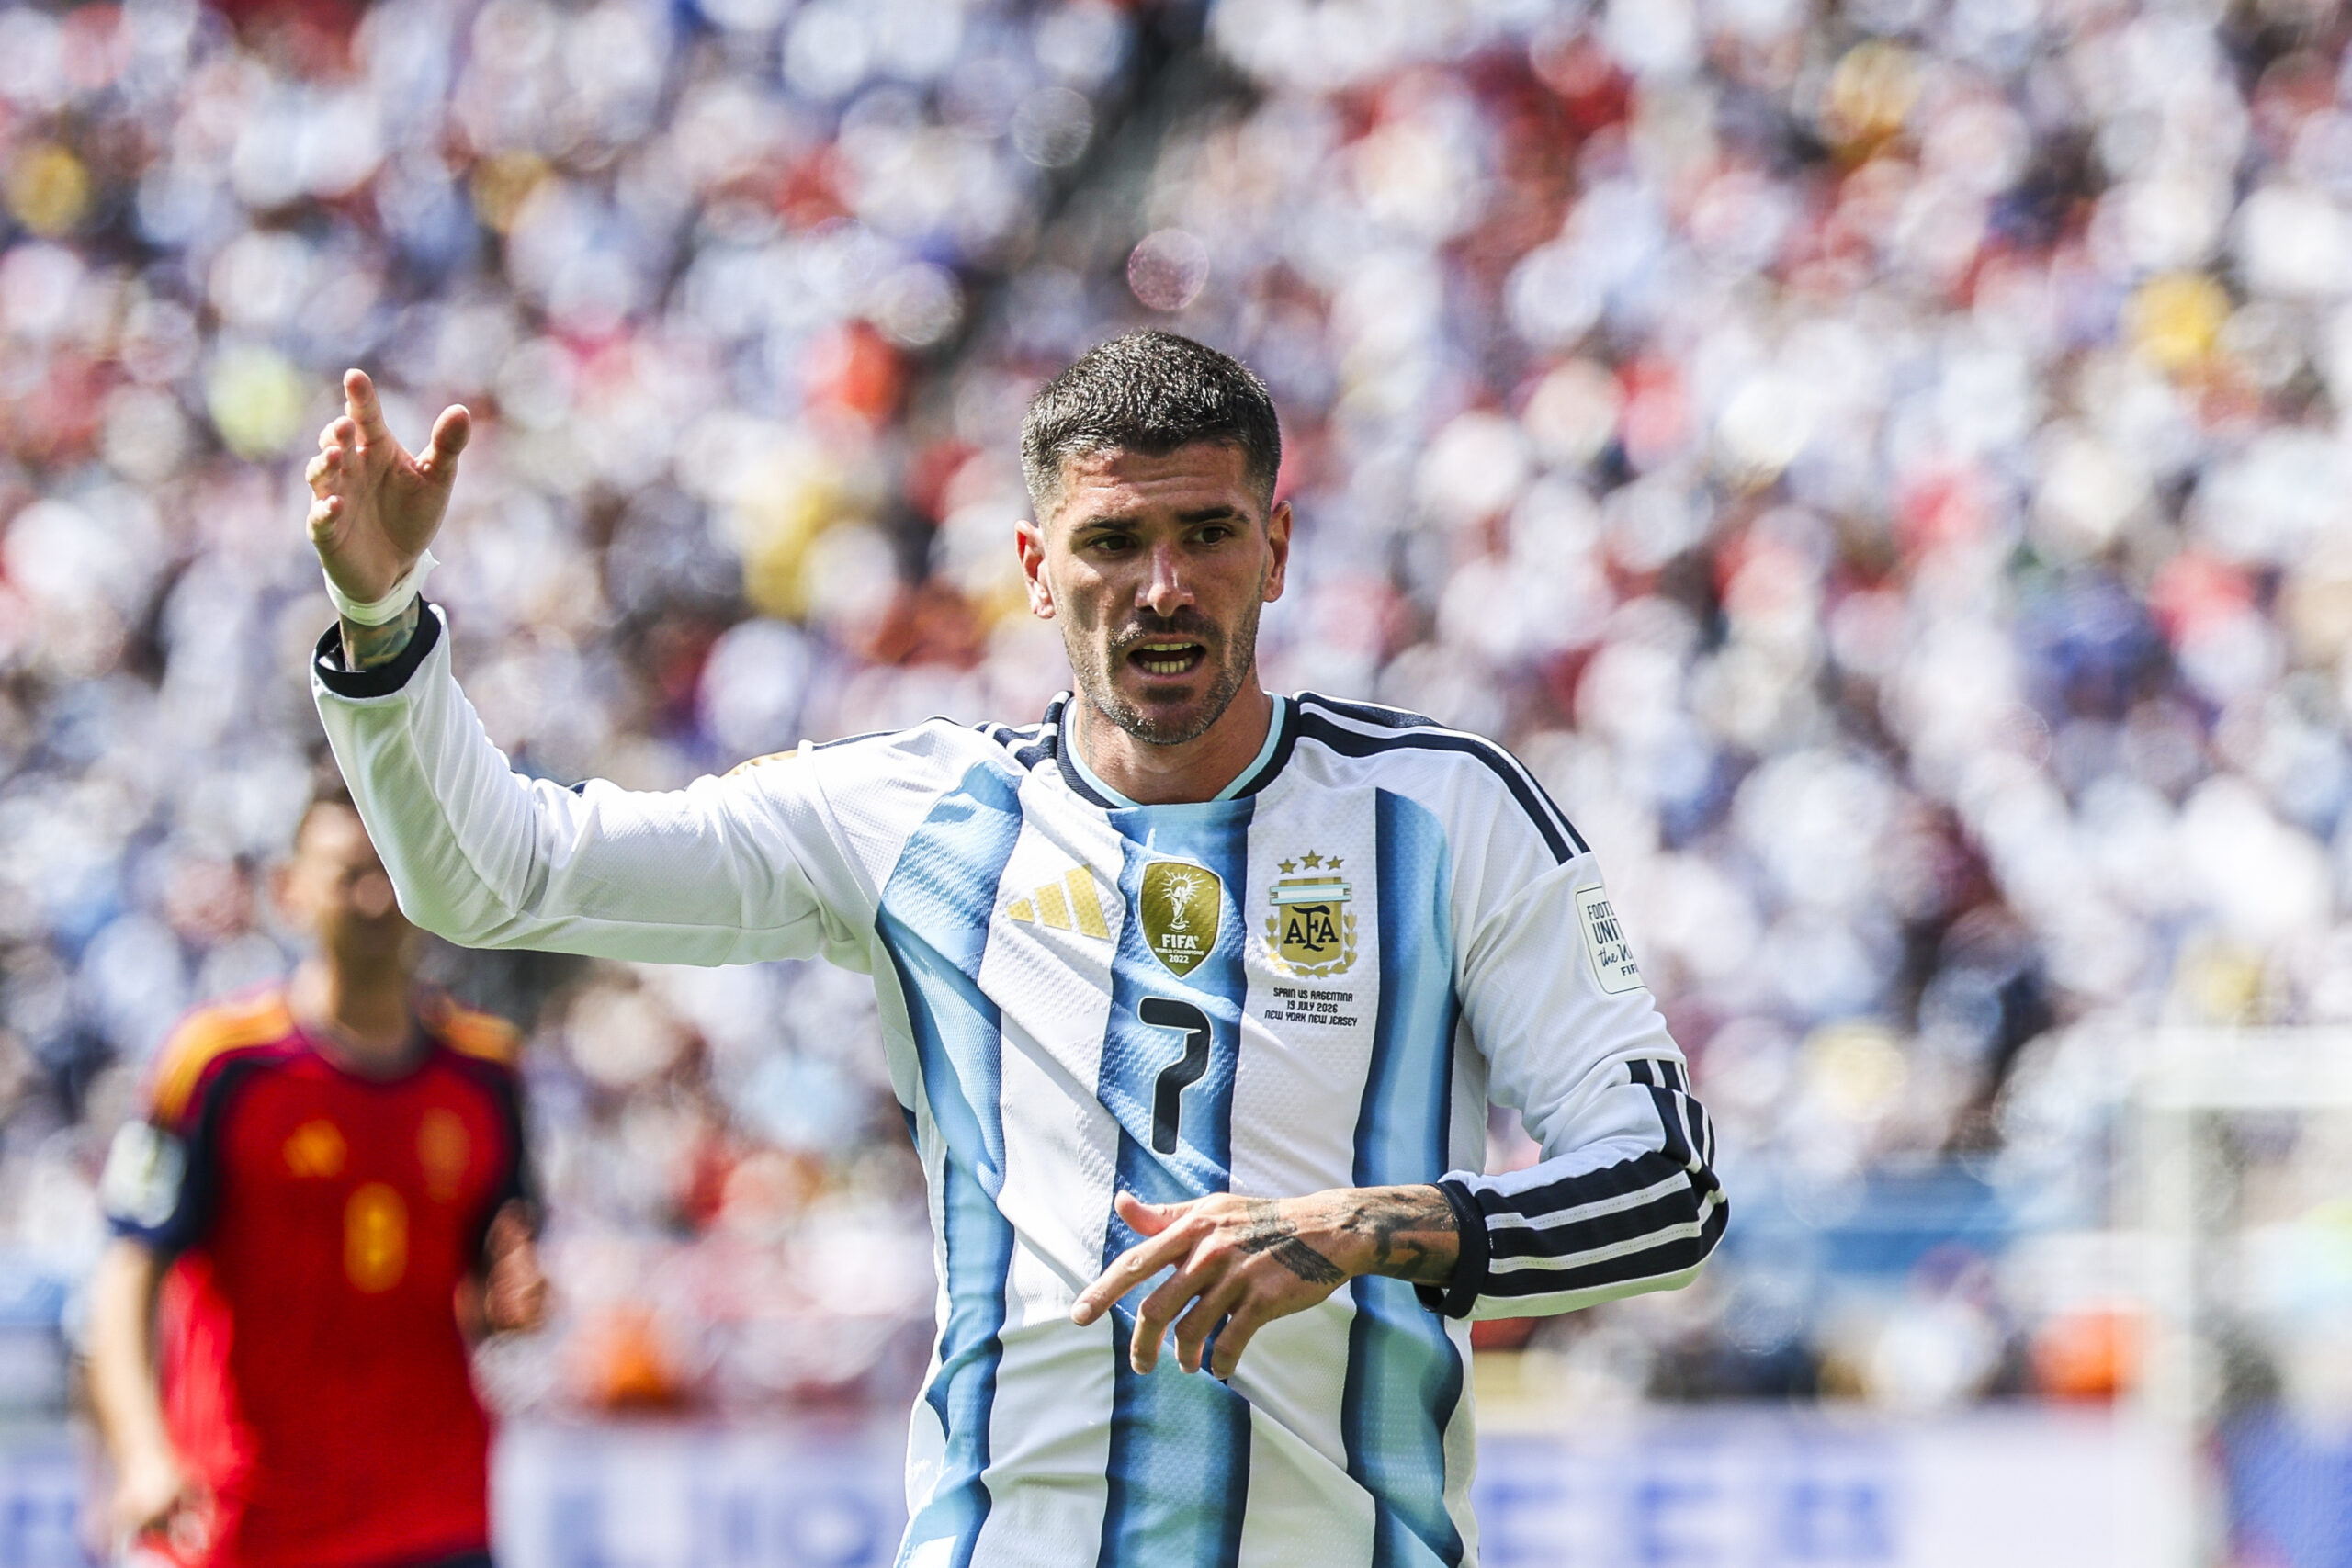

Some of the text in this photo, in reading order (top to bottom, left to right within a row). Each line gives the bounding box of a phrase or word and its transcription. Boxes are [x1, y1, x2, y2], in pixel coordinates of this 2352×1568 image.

[1283, 905, 1339, 952] AFA
[1169, 954, 1189, 964] 2022
[1598, 947, 1618, 967] the
[1273, 987, 1353, 1002] SPAIN VS ARGENTINA
[1287, 1000, 1339, 1013] 19 JULY 2026
[1264, 1010, 1358, 1027] NEW YORK NEW JERSEY
[1138, 996, 1212, 1156] 7
